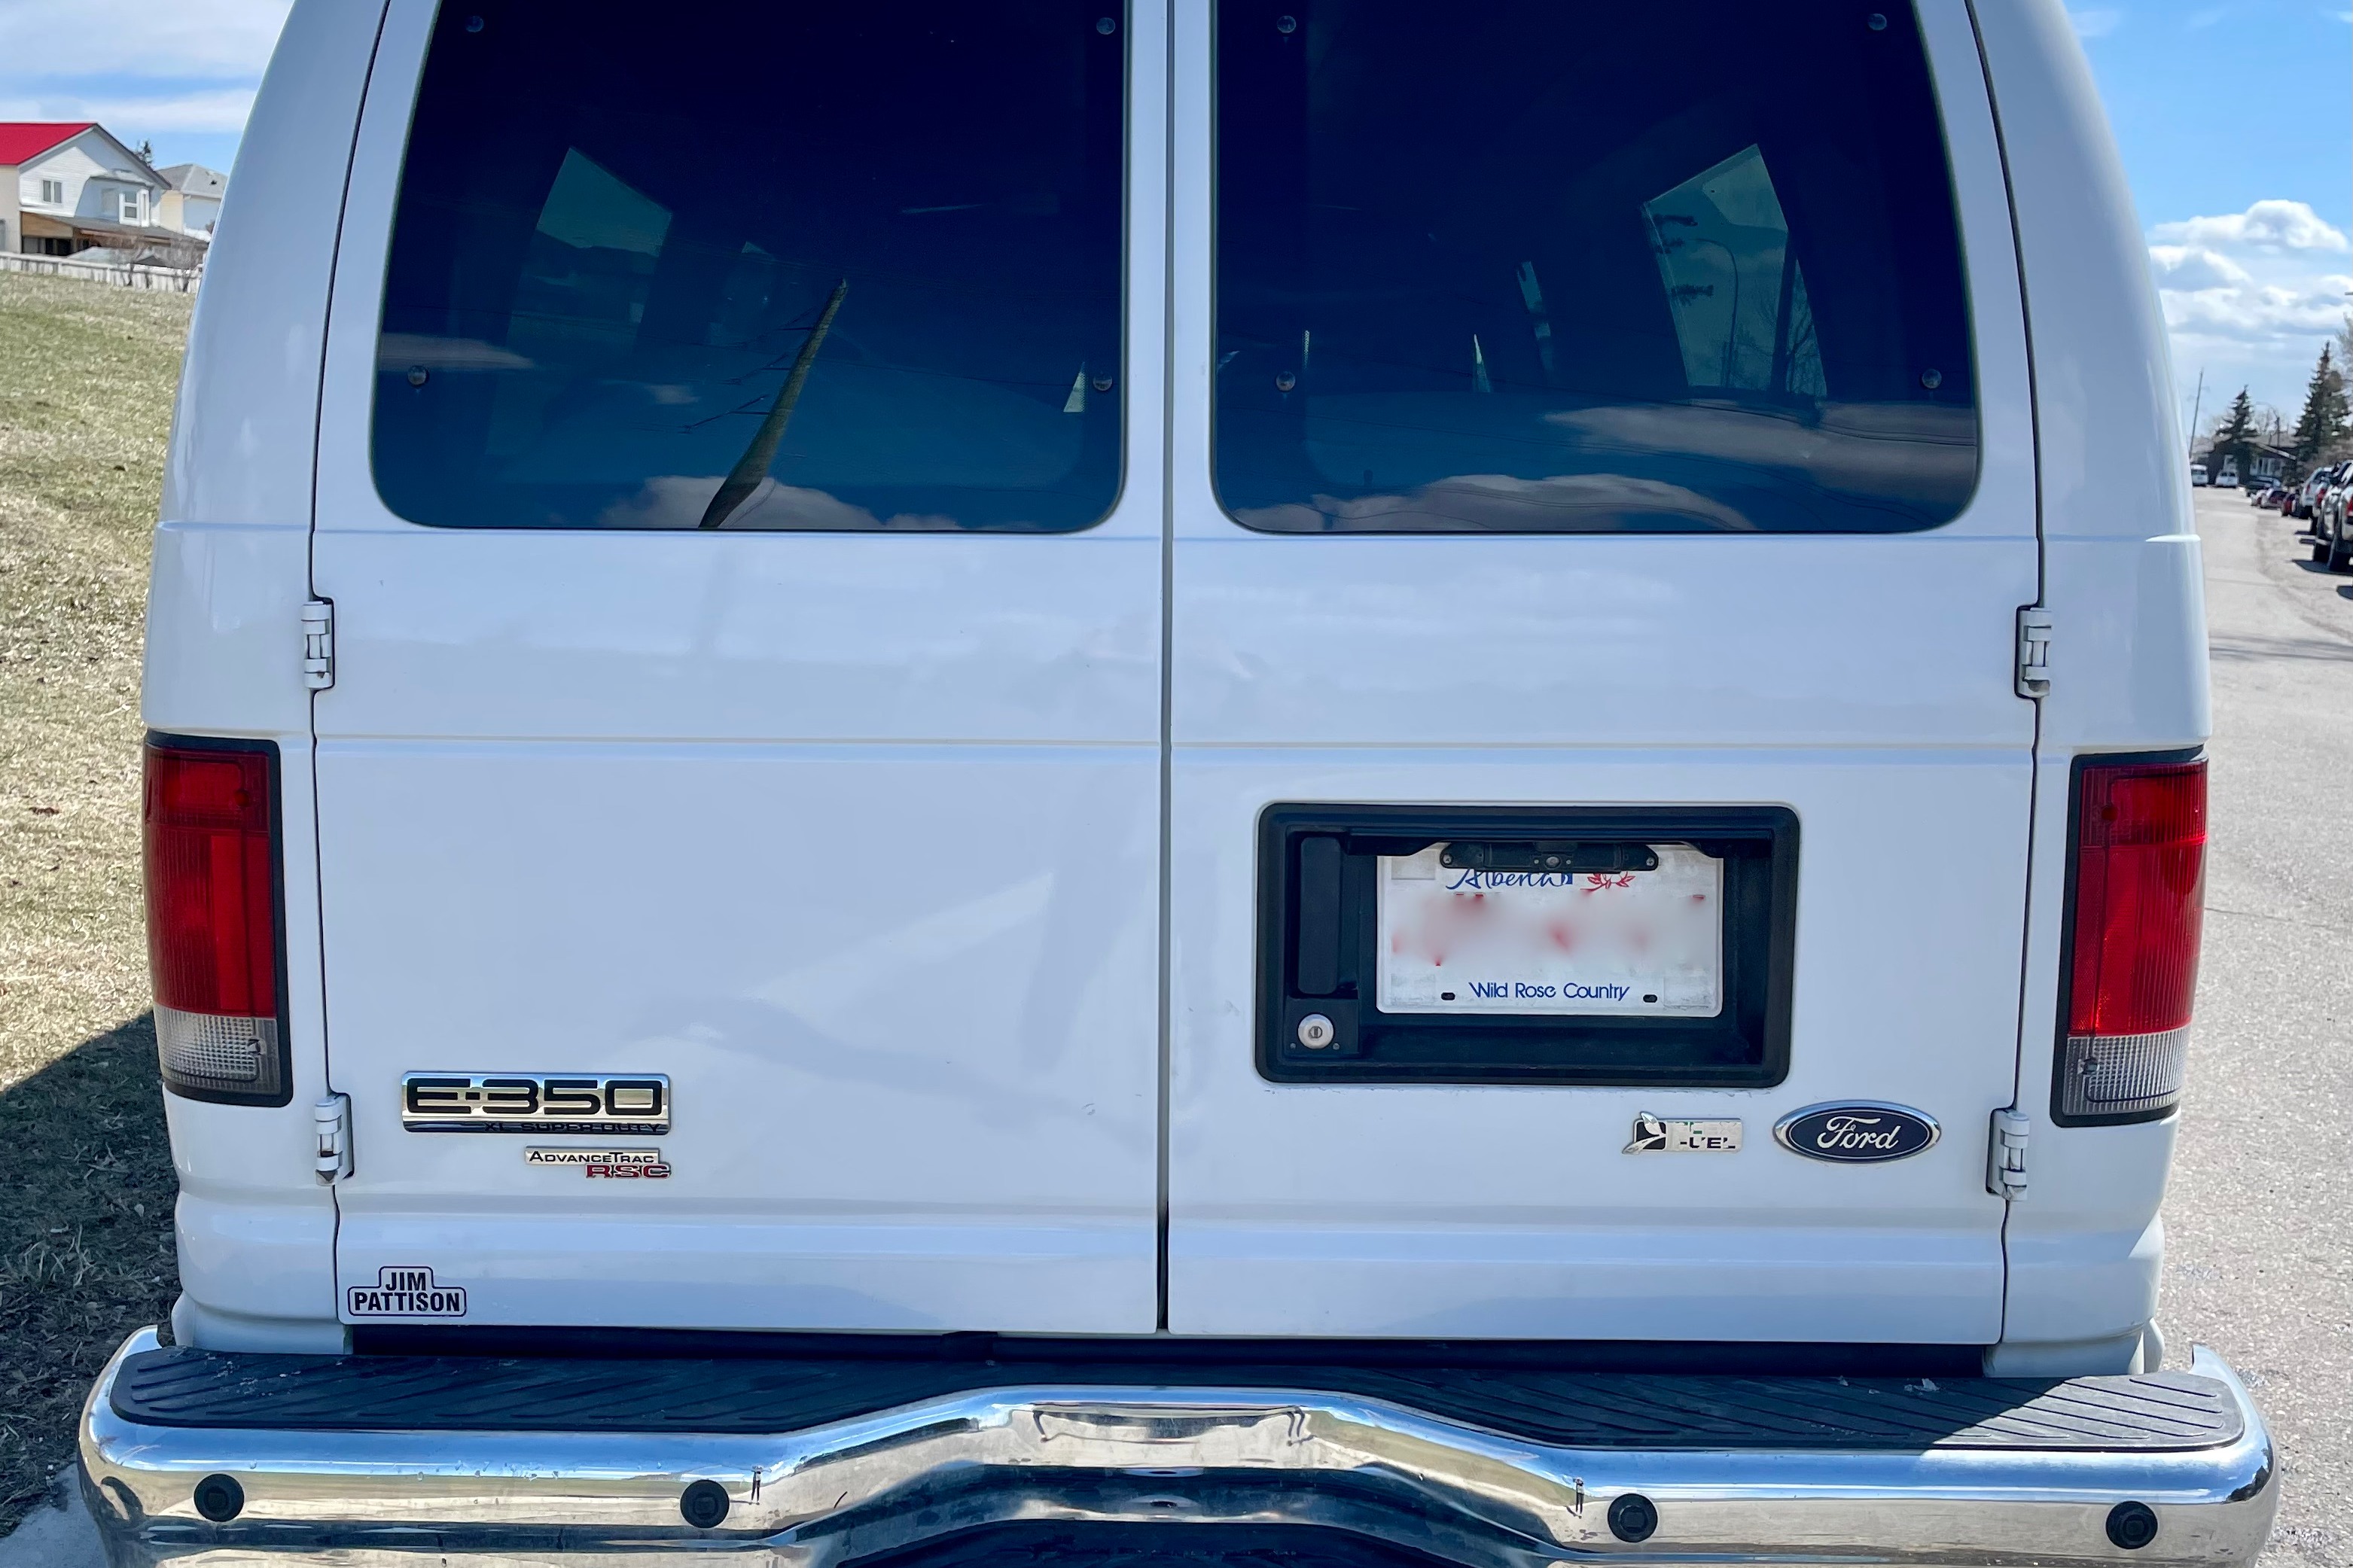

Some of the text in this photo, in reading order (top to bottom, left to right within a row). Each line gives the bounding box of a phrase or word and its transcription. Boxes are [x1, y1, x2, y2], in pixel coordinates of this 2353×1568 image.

[1468, 982, 1630, 1001] Wild Rose Country
[520, 1122, 594, 1133] SUPER
[602, 1122, 661, 1134] DUTY
[1818, 1116, 1901, 1149] Ford
[586, 1165, 671, 1178] RSC
[386, 1272, 426, 1291] JIM
[354, 1292, 460, 1312] PATTISON
